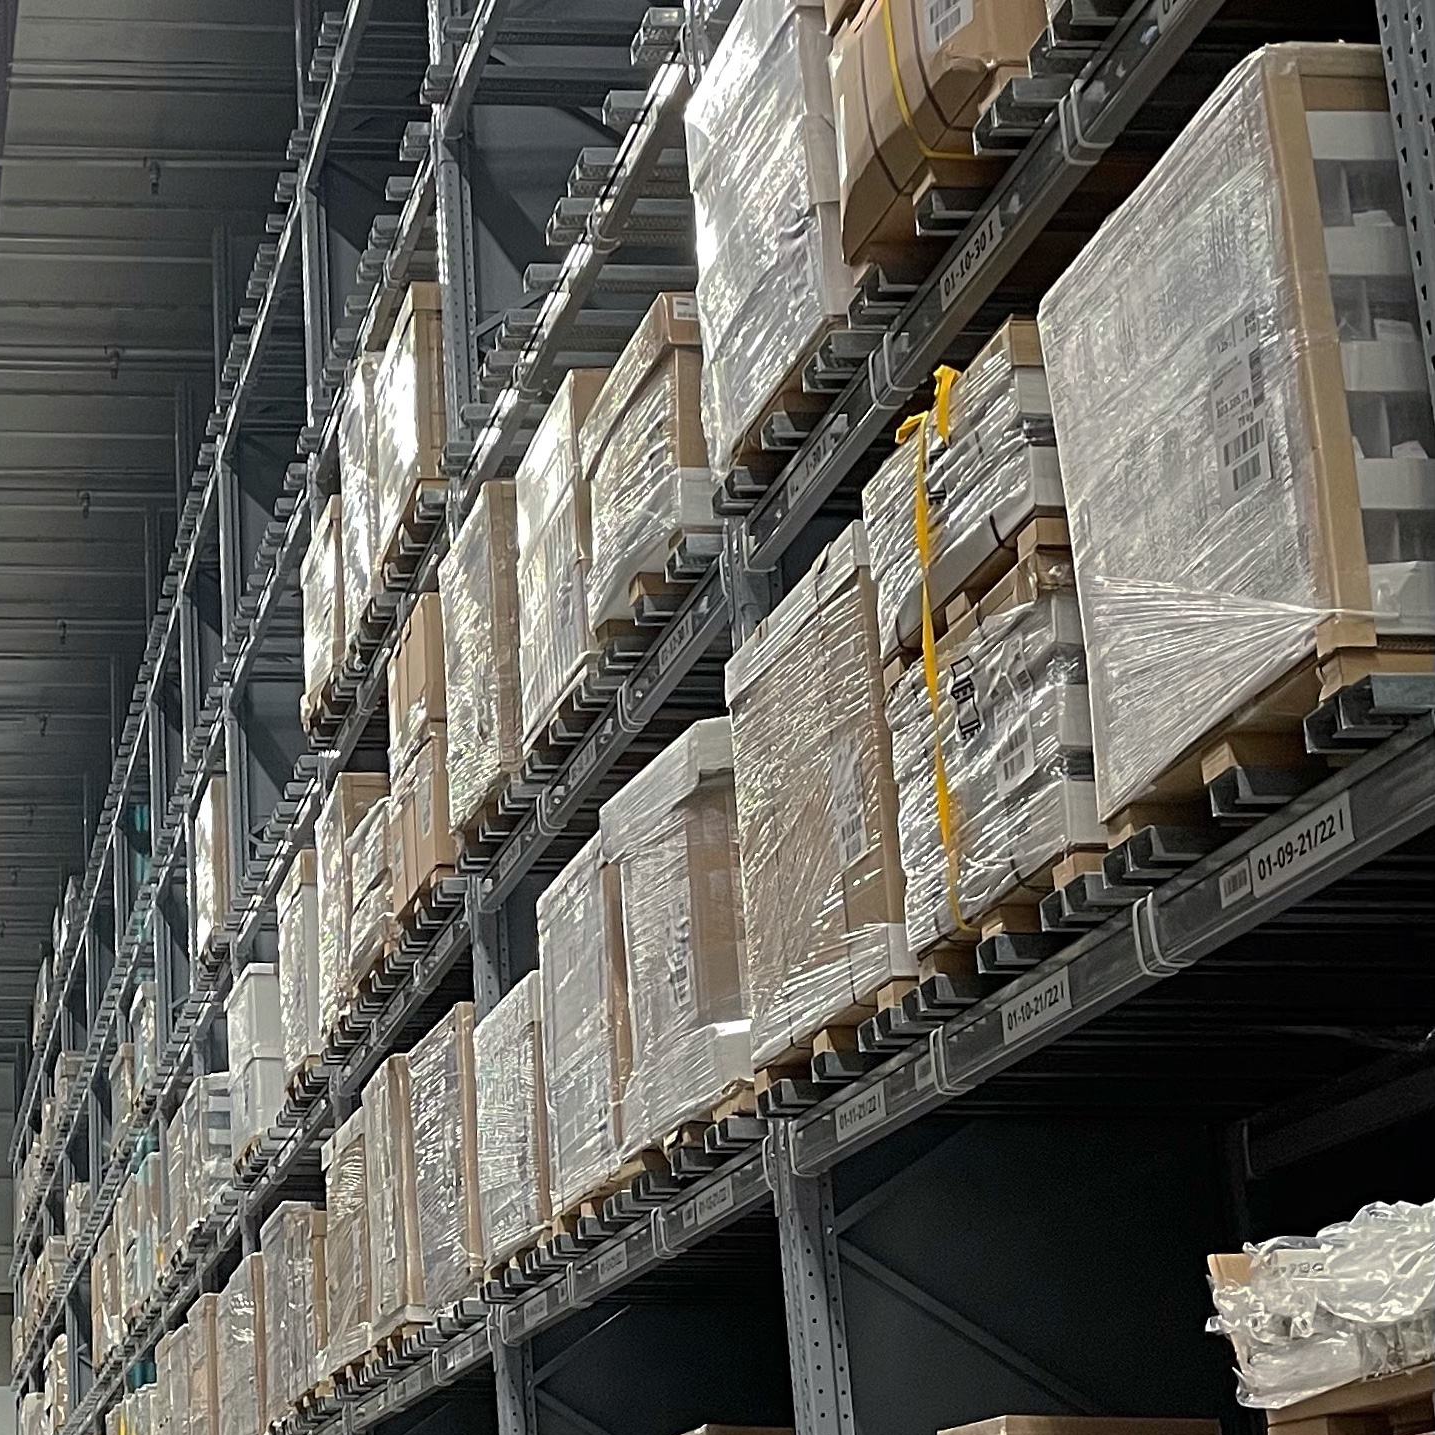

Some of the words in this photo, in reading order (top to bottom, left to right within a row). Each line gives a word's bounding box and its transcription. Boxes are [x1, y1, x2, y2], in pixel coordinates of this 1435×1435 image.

[944, 229, 987, 297] 01-10-30
[1257, 817, 1336, 881] 01-09-21/22
[1007, 986, 1060, 1031] 01-10-21/22
